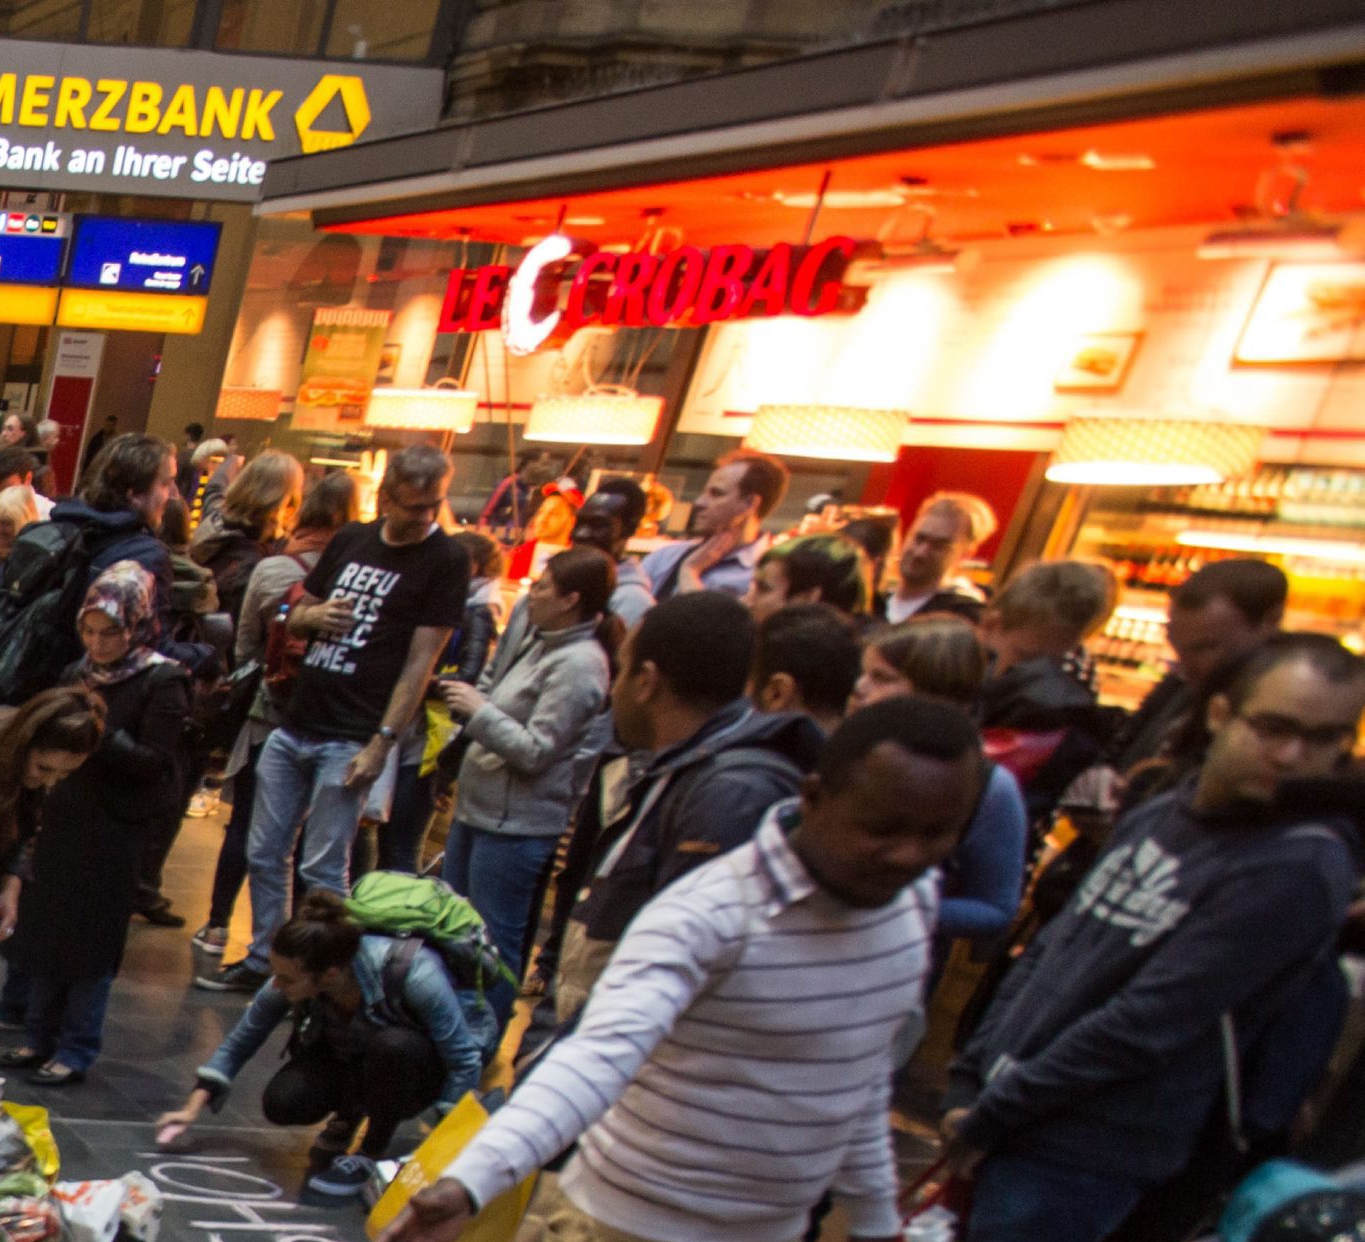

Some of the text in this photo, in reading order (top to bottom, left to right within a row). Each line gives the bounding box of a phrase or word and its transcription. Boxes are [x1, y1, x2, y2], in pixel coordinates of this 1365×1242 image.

[68, 148, 105, 175] an
[112, 145, 187, 180] Ihrer
[190, 150, 266, 185] Seite
[438, 236, 855, 333] LE CROBAG
[336, 562, 401, 597] REFU
